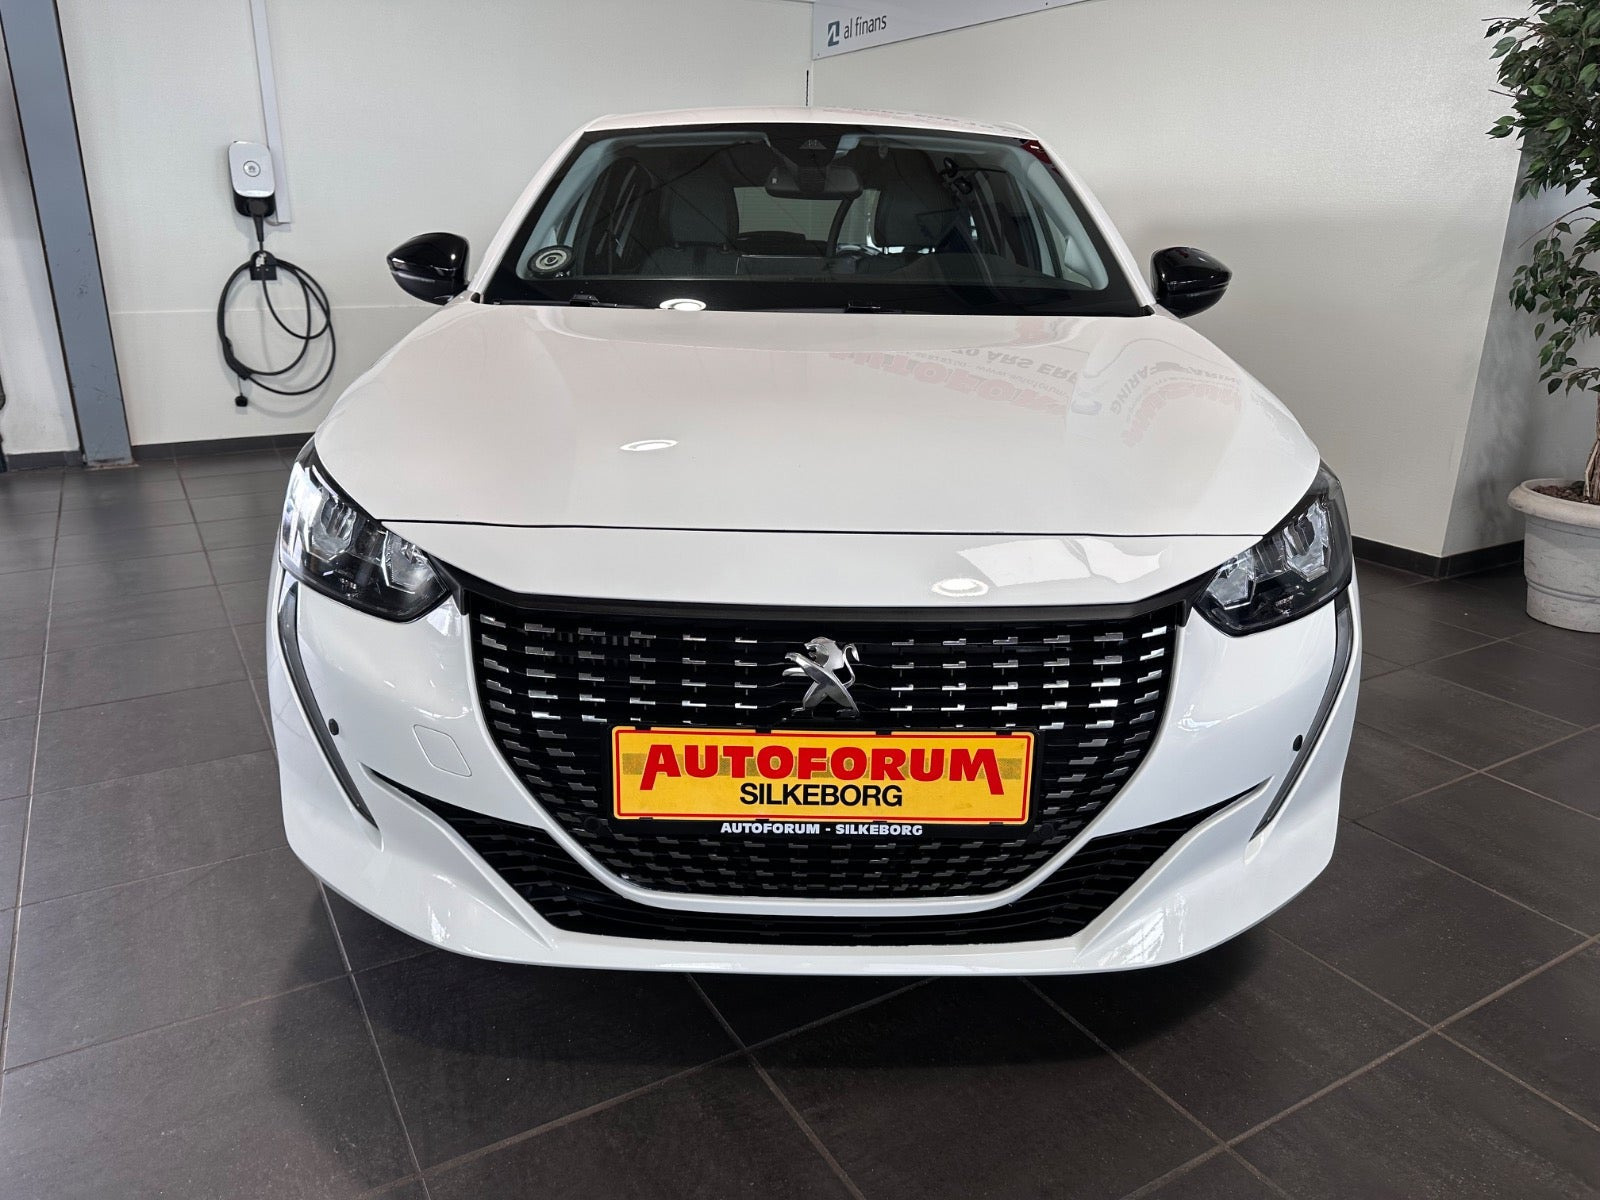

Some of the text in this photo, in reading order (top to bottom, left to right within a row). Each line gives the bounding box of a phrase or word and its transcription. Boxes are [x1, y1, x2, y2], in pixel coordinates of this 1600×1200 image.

[843, 15, 887, 40] al finans
[640, 744, 1005, 796] AUTOFORUM
[739, 782, 903, 807] SILKEBORG
[720, 822, 820, 835] AUTOFORUM
[835, 823, 923, 836] SILKEBORG
